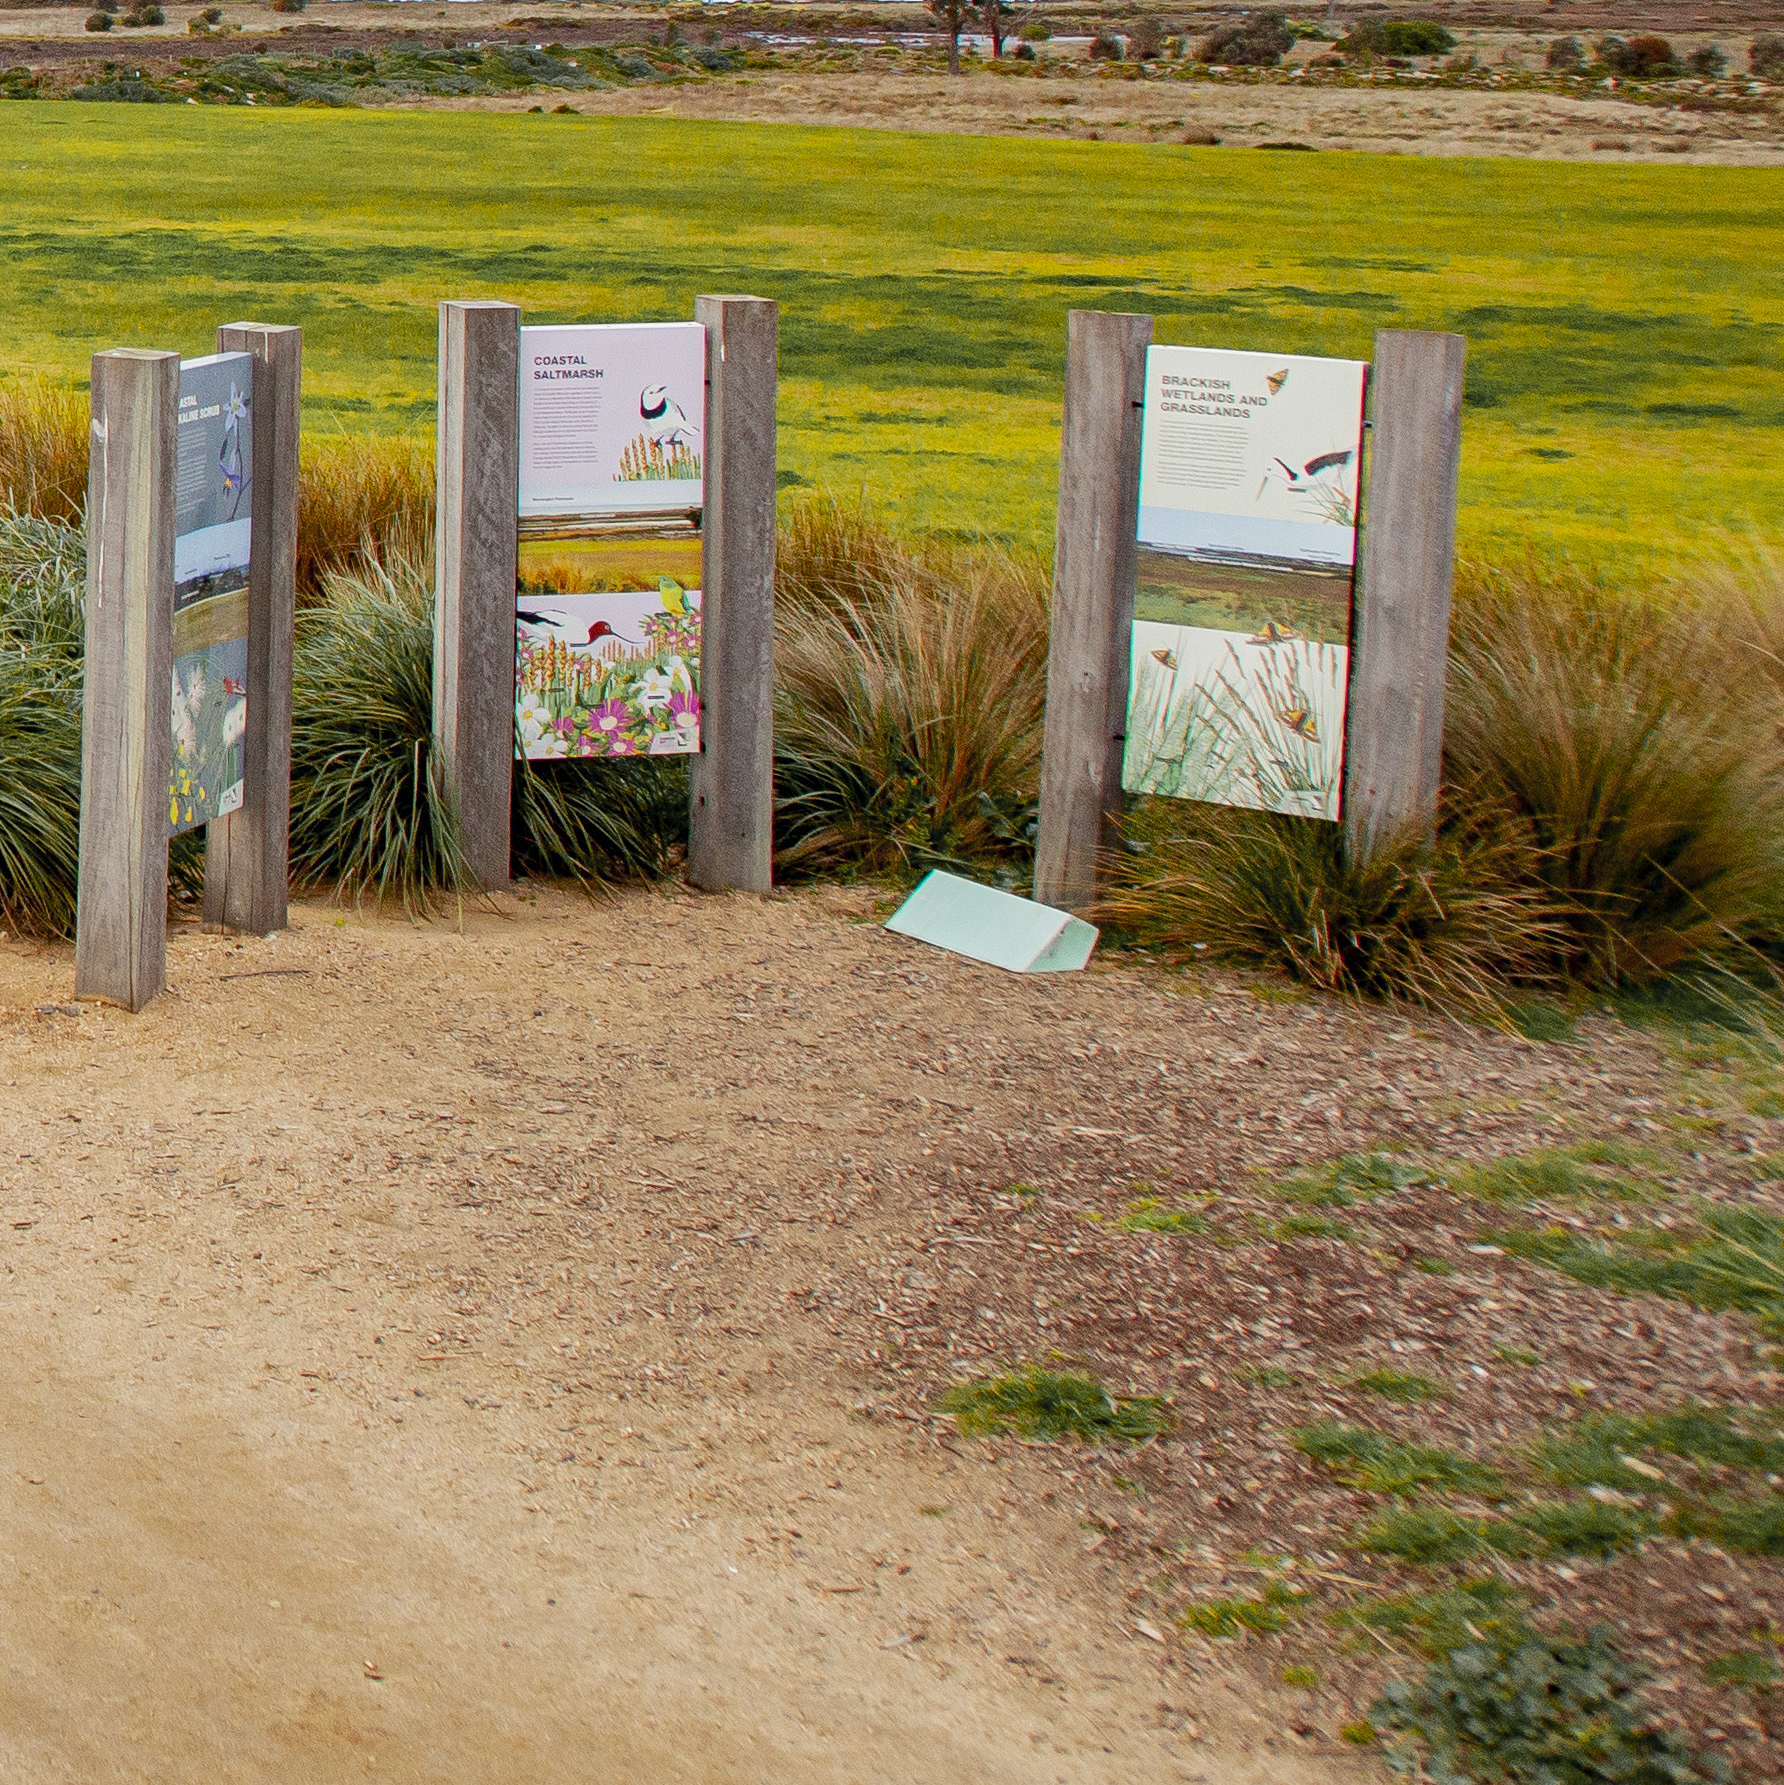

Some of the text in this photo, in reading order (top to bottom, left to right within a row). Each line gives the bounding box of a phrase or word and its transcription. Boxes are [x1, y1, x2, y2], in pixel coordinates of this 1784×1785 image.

[534, 355, 587, 366] COASTAL
[534, 369, 604, 379] SALTMARSH
[1162, 375, 1231, 389] BRACKISH
[179, 395, 198, 409] ASTAL
[1161, 389, 1268, 406] WETLANDS AND
[178, 409, 199, 424] KALINE
[1160, 402, 1250, 418] GRASSLANDS
